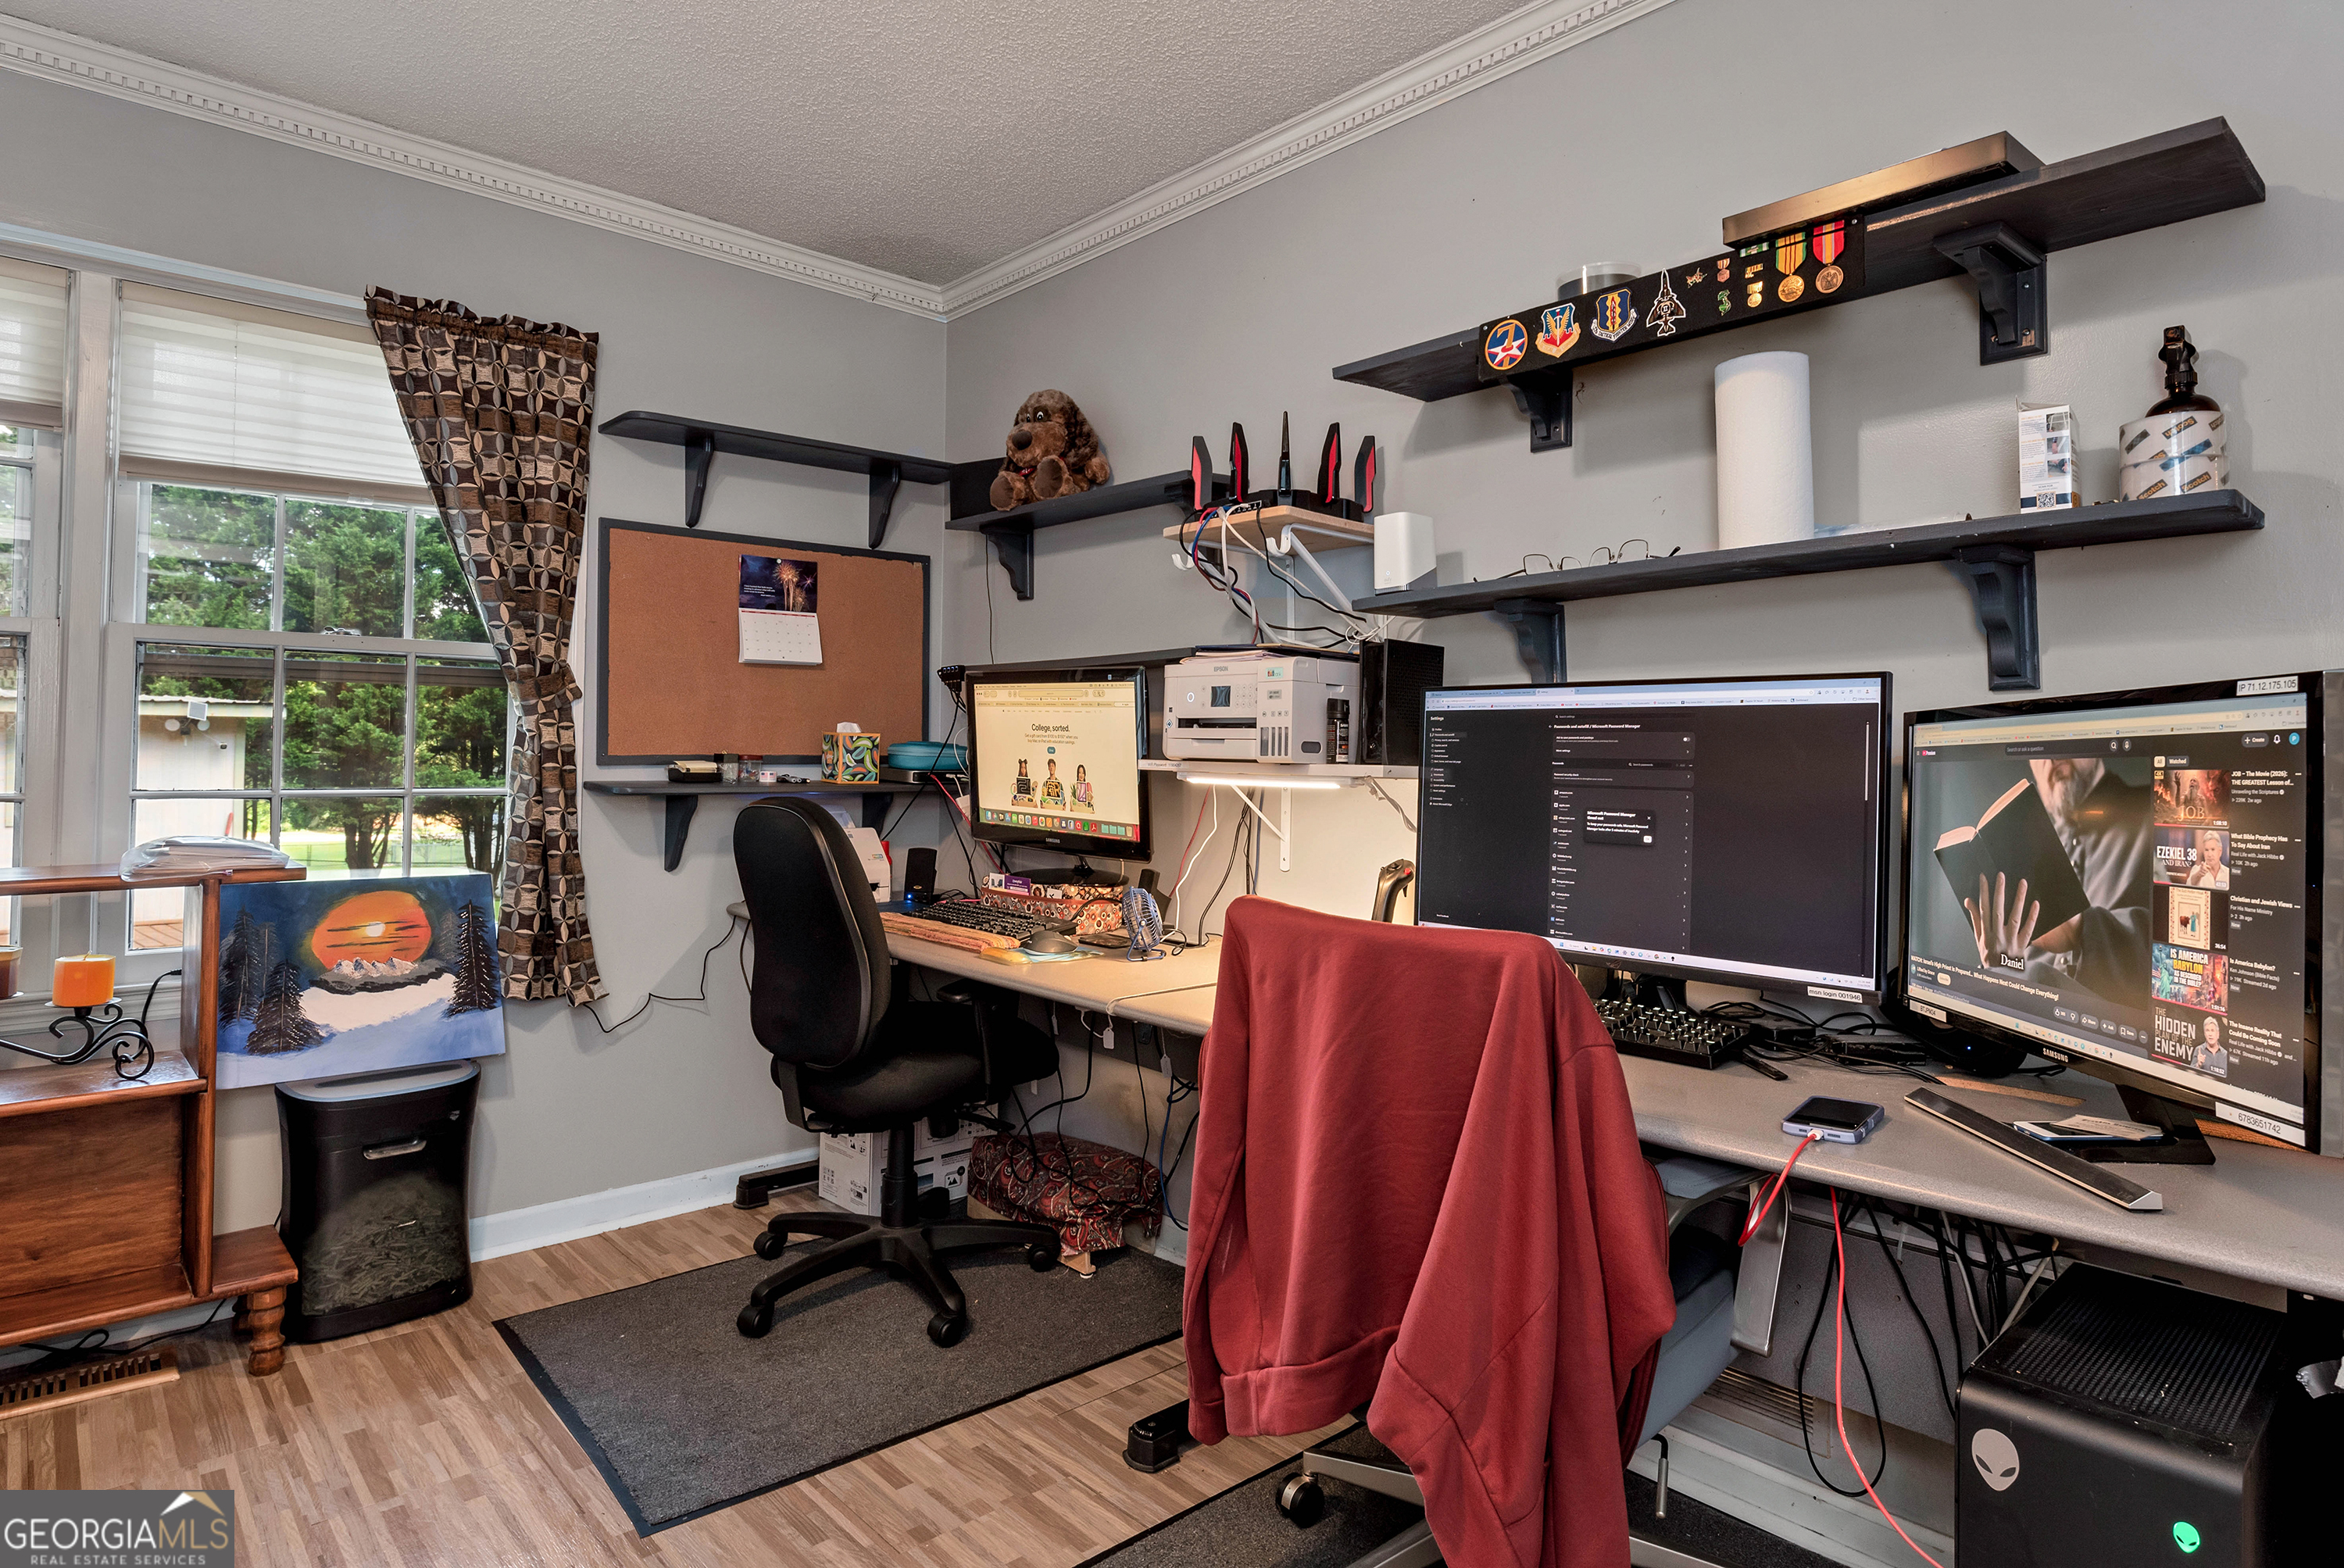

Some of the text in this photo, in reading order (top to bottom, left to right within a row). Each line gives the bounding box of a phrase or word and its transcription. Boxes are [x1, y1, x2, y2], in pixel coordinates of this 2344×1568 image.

[1613, 327, 1628, 339] FIGHTER
[2181, 473, 2210, 491] Scotch
[2139, 482, 2165, 499] Scotch
[2247, 680, 2296, 691] 71.12.175.105
[1031, 723, 1052, 733] College,
[2178, 805, 2205, 821] JOB
[2255, 834, 2277, 843] Prophecy
[2156, 845, 2197, 862] EZEKIEL 38
[2000, 954, 2024, 970] Daniel
[2170, 948, 2208, 965] IS AMERICA
[2173, 959, 2203, 975] BABYLON
[2235, 959, 2253, 968] America
[2254, 962, 2275, 971] Babylon?
[2243, 978, 2262, 987] Streamed
[2267, 973, 2280, 982] Facts)
[1983, 975, 1999, 984] Happens
[1999, 978, 2009, 988] Next
[2009, 981, 2020, 990] Could
[2021, 984, 2035, 995] Change
[2035, 988, 2059, 1001] Everything!
[2155, 1007, 2167, 1016] THE
[2155, 1015, 2196, 1039] HIDDEN
[2239, 1023, 2253, 1031] Insane
[2254, 1026, 2271, 1037] Reality
[2271, 1030, 2282, 1039] That
[2155, 1030, 2170, 1040] PLAN
[2181, 1036, 2192, 1046] THE
[2229, 1030, 2242, 1038] Could
[2249, 1034, 2267, 1045] Coming
[2268, 1039, 2281, 1048] Soon
[2042, 1048, 2069, 1063] SAMSUNG
[2155, 1038, 2194, 1061] ENEMY
[2242, 1051, 2261, 1061] Streamed
[2265, 1048, 2277, 1056] Hibbs
[2238, 1113, 2281, 1134] 6783651742
